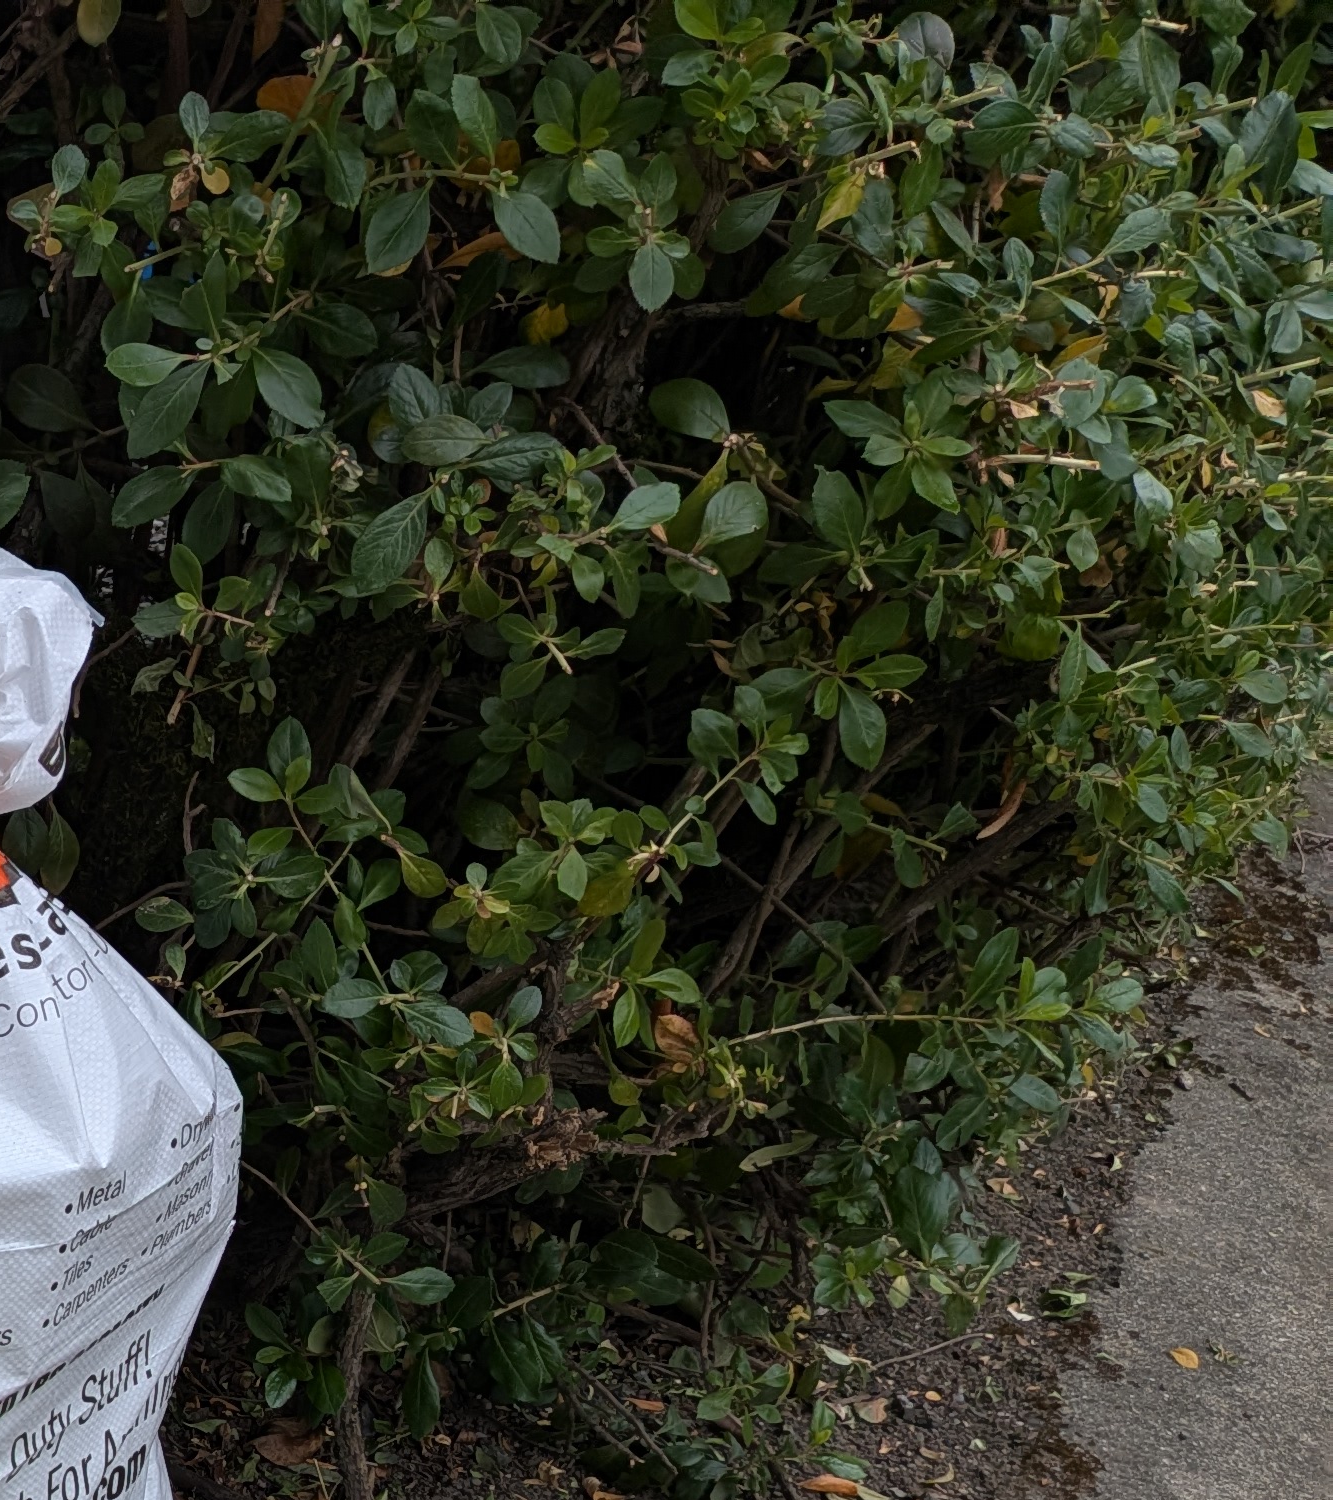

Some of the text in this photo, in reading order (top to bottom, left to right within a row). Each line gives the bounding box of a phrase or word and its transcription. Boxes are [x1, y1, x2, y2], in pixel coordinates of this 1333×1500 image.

[76, 1169, 127, 1216] Metal
[149, 1199, 213, 1257] Plumbers
[52, 1257, 131, 1328] Carpenters
[61, 1253, 94, 1290] Tiles
[5, 1403, 73, 1484] Duty
[79, 1328, 153, 1426] Stuff!
